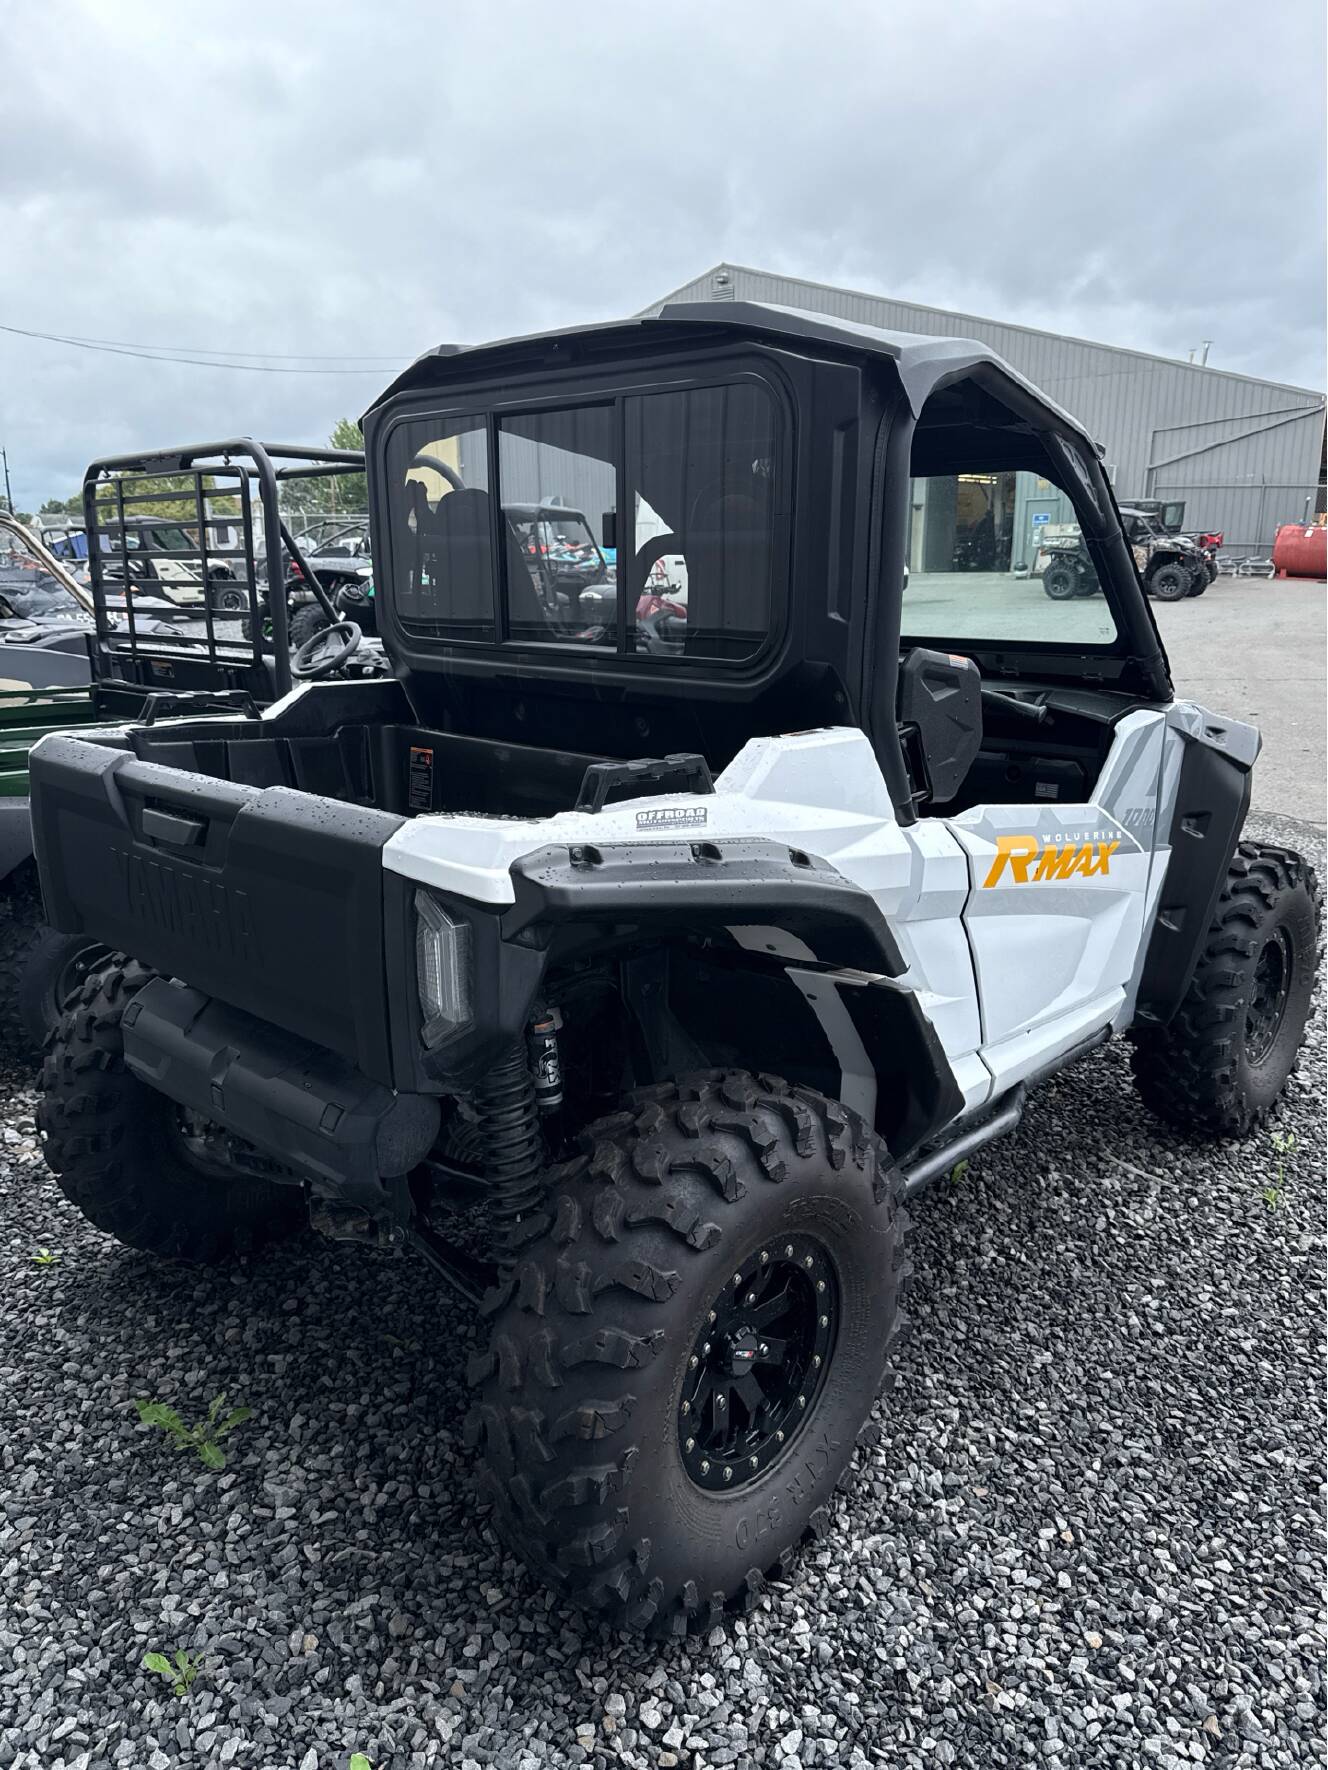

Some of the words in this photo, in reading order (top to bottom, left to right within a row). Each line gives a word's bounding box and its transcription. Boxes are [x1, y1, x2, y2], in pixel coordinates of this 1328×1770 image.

[637, 808, 706, 821] OFFROAD
[1042, 831, 1122, 843] WOLVERINE
[106, 846, 265, 967] YAMAHA
